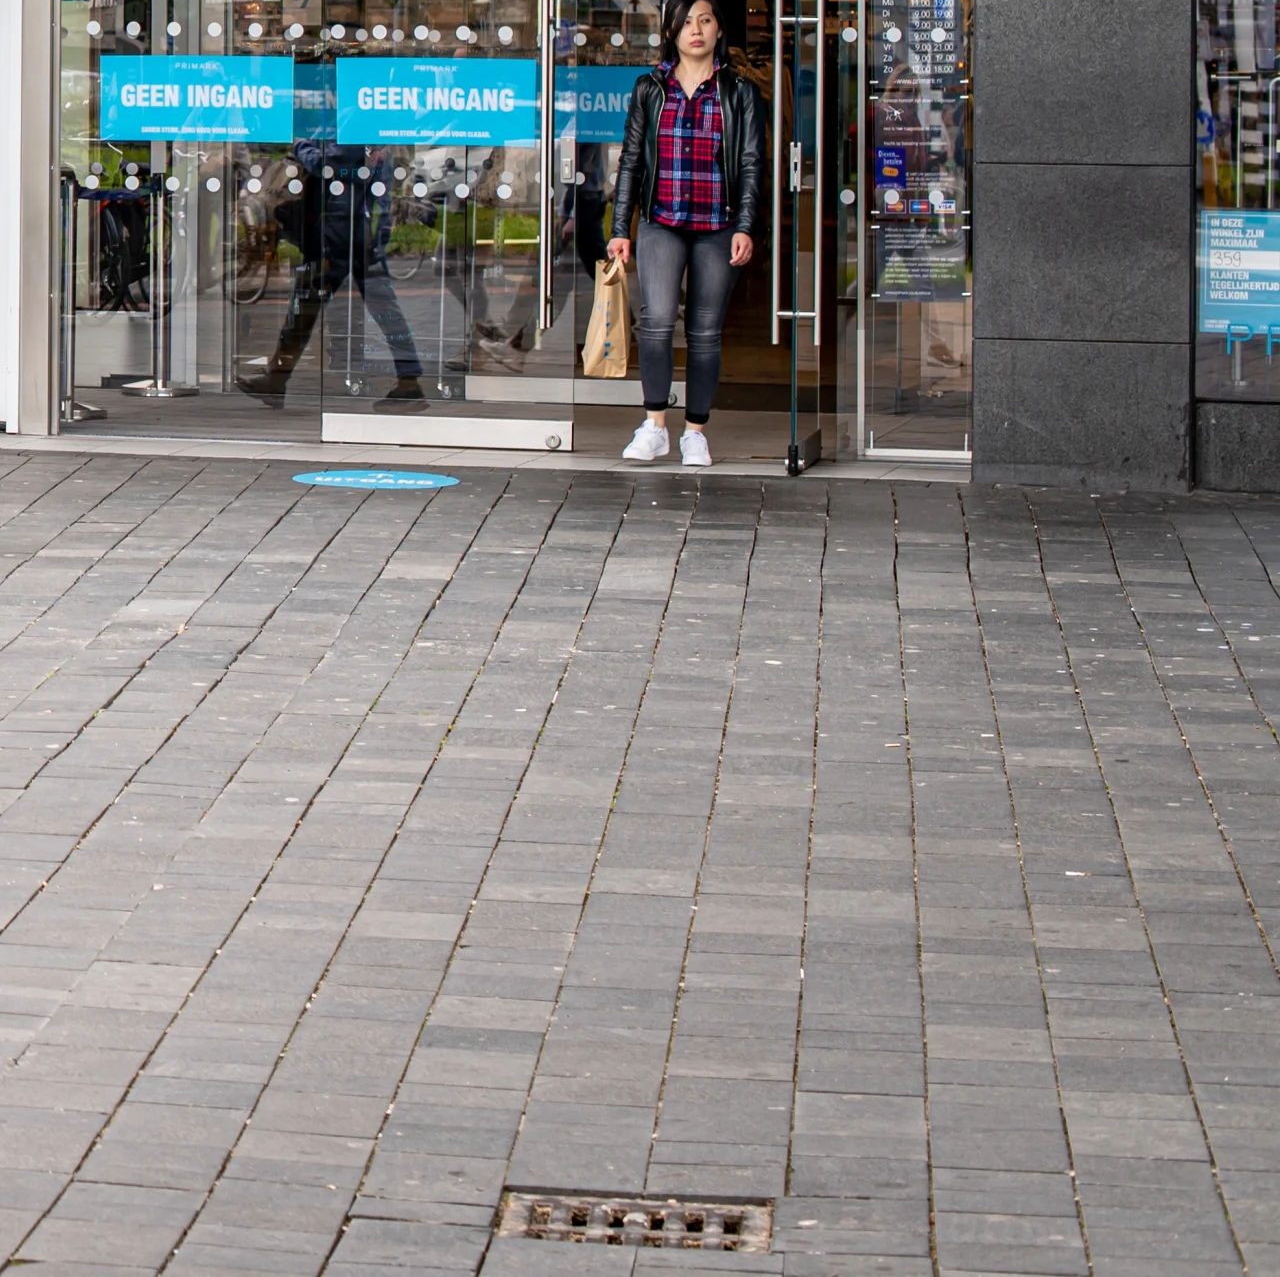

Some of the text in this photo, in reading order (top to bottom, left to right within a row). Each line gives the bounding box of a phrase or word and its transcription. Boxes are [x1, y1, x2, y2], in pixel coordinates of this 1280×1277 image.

[911, 0, 931, 7] 11.00
[935, 0, 954, 7] 19.00
[174, 62, 219, 70] PRIMARK
[413, 64, 457, 72] PRIMARK
[883, 65, 894, 73] Zo
[934, 65, 954, 73] 18.00
[120, 84, 274, 109] GEEN INGANG
[293, 89, 337, 110] GEEN
[357, 86, 515, 113] GEEN INGANG
[1210, 218, 1244, 228] IN DEZE
[1210, 228, 1265, 238] WINKEL ZIJN
[1210, 238, 1259, 249] MAXIMAAL
[1213, 250, 1242, 268] 359
[1210, 270, 1250, 280] KLANTEN
[1210, 280, 1280, 291] TEGELIJKERTIJD
[1210, 290, 1249, 301] WELKOM
[314, 476, 435, 485] UITGANG
